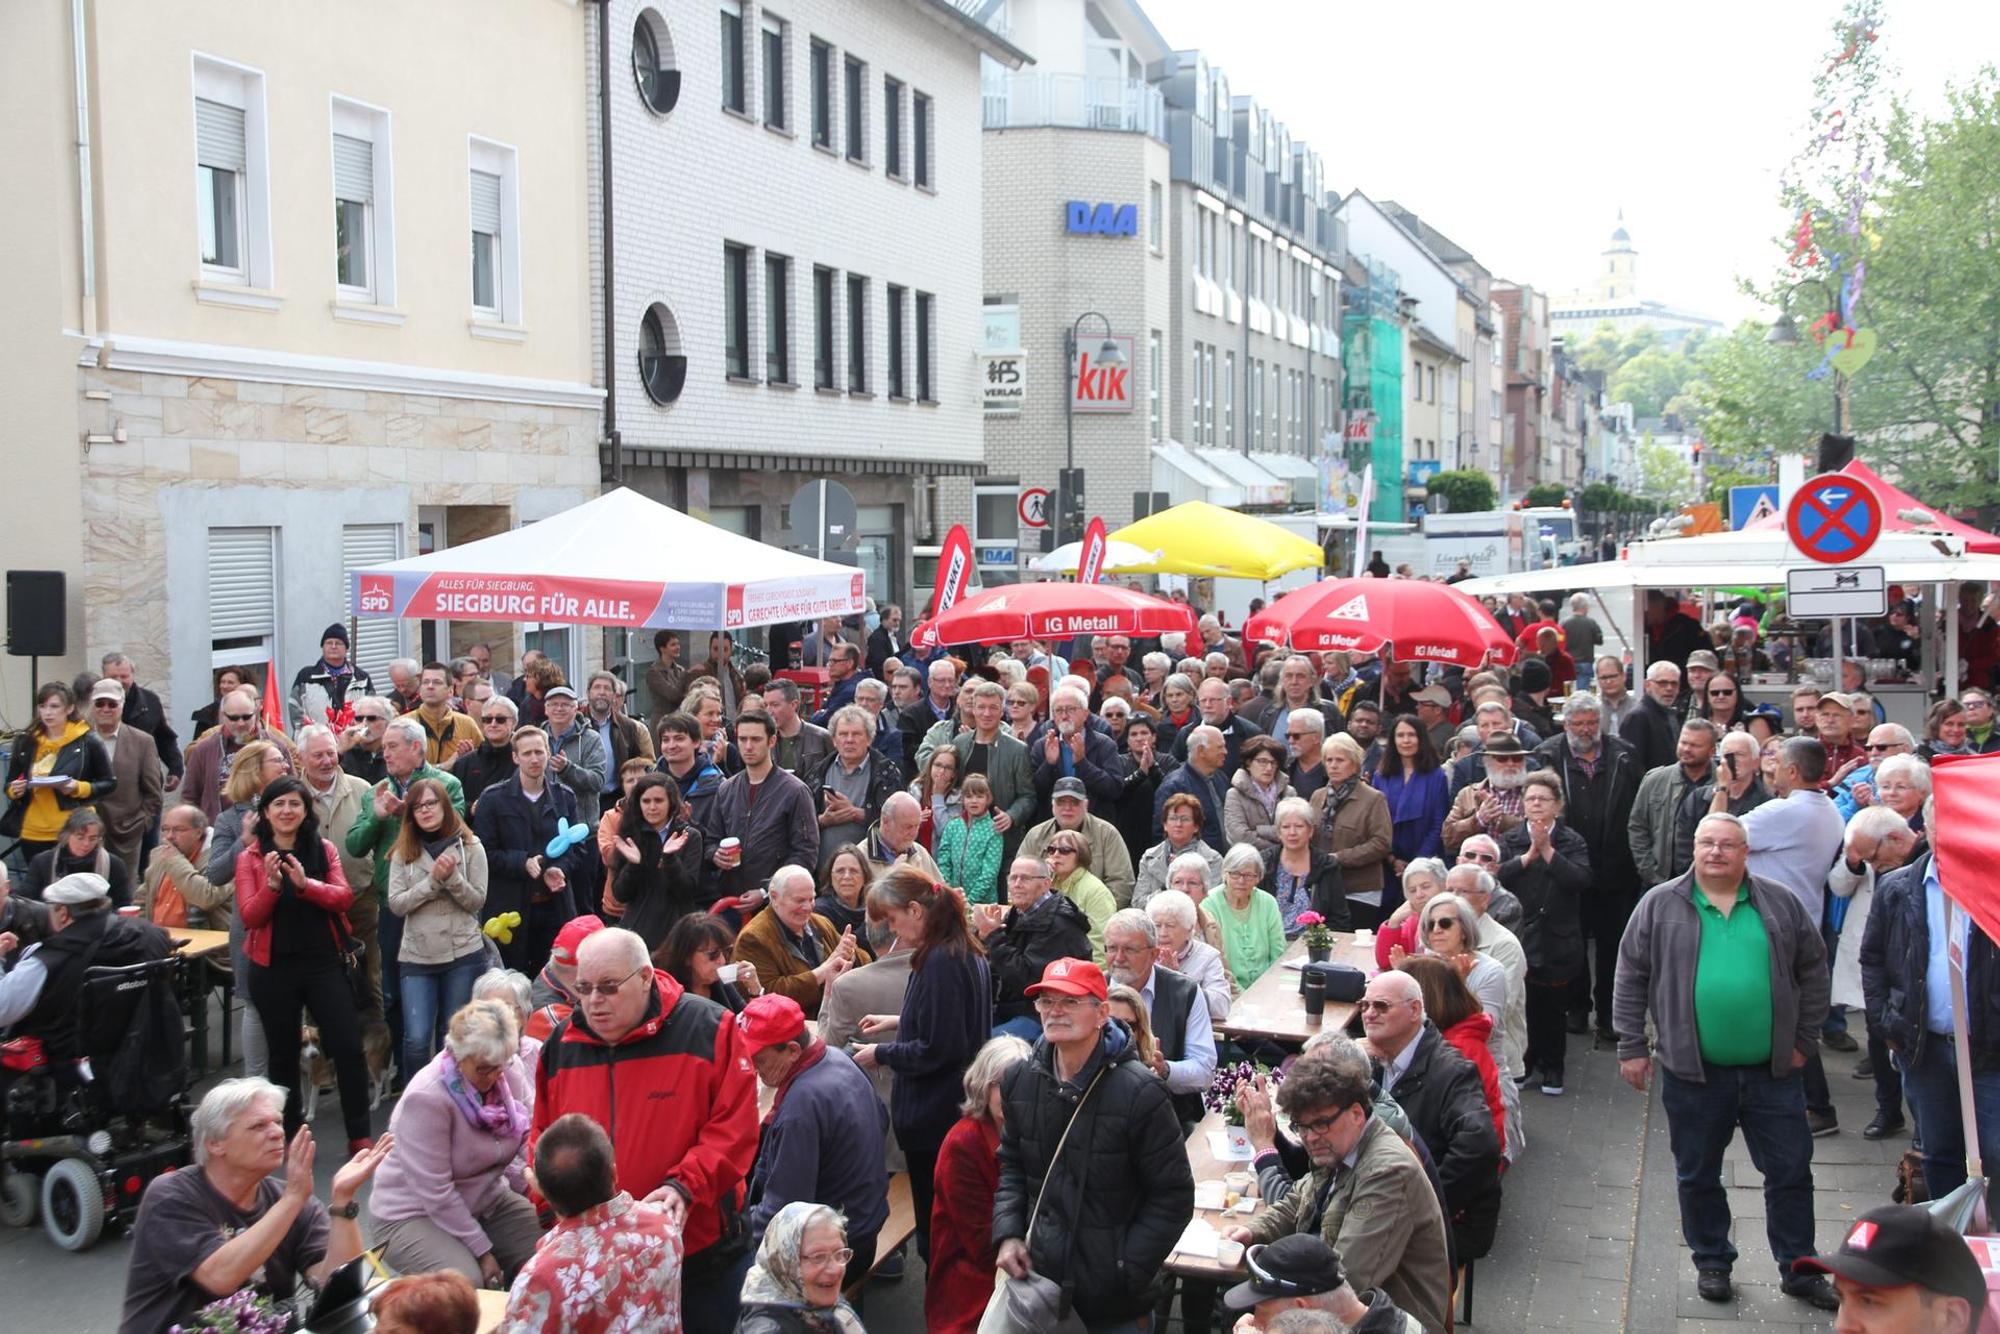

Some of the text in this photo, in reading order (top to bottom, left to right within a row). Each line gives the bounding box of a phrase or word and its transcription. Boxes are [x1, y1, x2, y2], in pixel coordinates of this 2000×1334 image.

[1066, 200, 1137, 237] DAA
[984, 387, 1023, 397] VERLAG
[984, 549, 1013, 563] DAA
[438, 579, 536, 592] ALLES FÜR SIEGBURG.
[361, 598, 389, 611] SPD
[435, 592, 636, 620] SIEGBURG FÜR ALLE.
[748, 605, 780, 622] GERECHTE
[801, 599, 813, 615] FÜR
[727, 608, 742, 624] SPD
[1045, 615, 1118, 632] IG Metall
[1318, 633, 1330, 646] IG
[1414, 645, 1426, 656] IG
